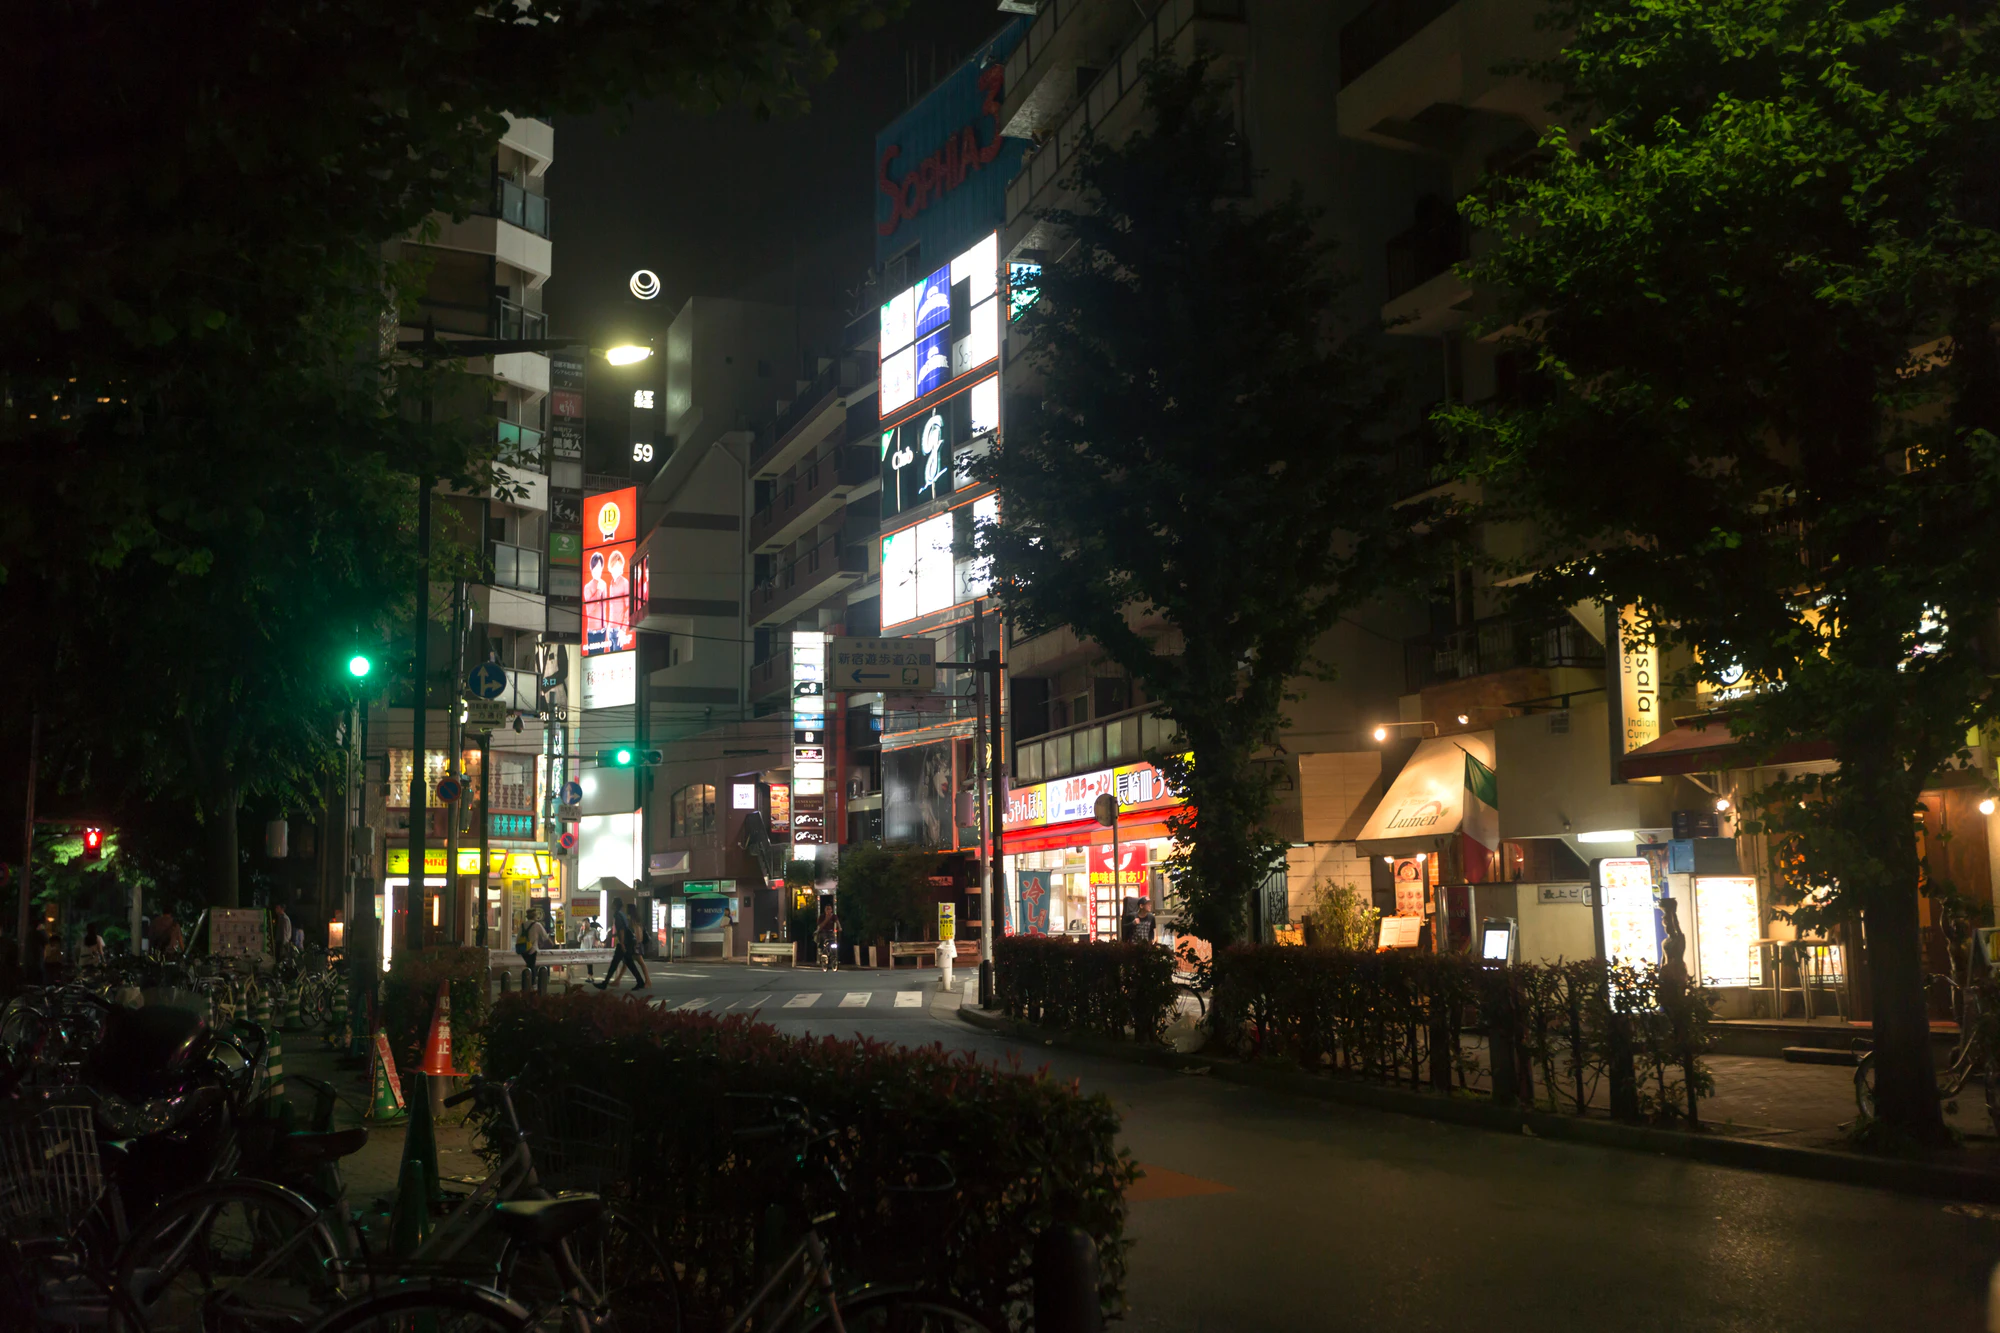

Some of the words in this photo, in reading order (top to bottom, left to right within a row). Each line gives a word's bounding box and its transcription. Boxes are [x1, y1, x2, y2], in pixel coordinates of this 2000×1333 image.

[633, 443, 653, 462] 59
[892, 446, 914, 470] Club
[603, 509, 616, 524] ID
[838, 653, 931, 666] 新宿遊歩道公園
[1627, 717, 1656, 728] Indian
[1627, 729, 1651, 742] Curry
[1065, 773, 1111, 803] 九州ラーメン
[1003, 790, 1045, 824] ちゃんぽん
[1385, 809, 1438, 829] Lumen
